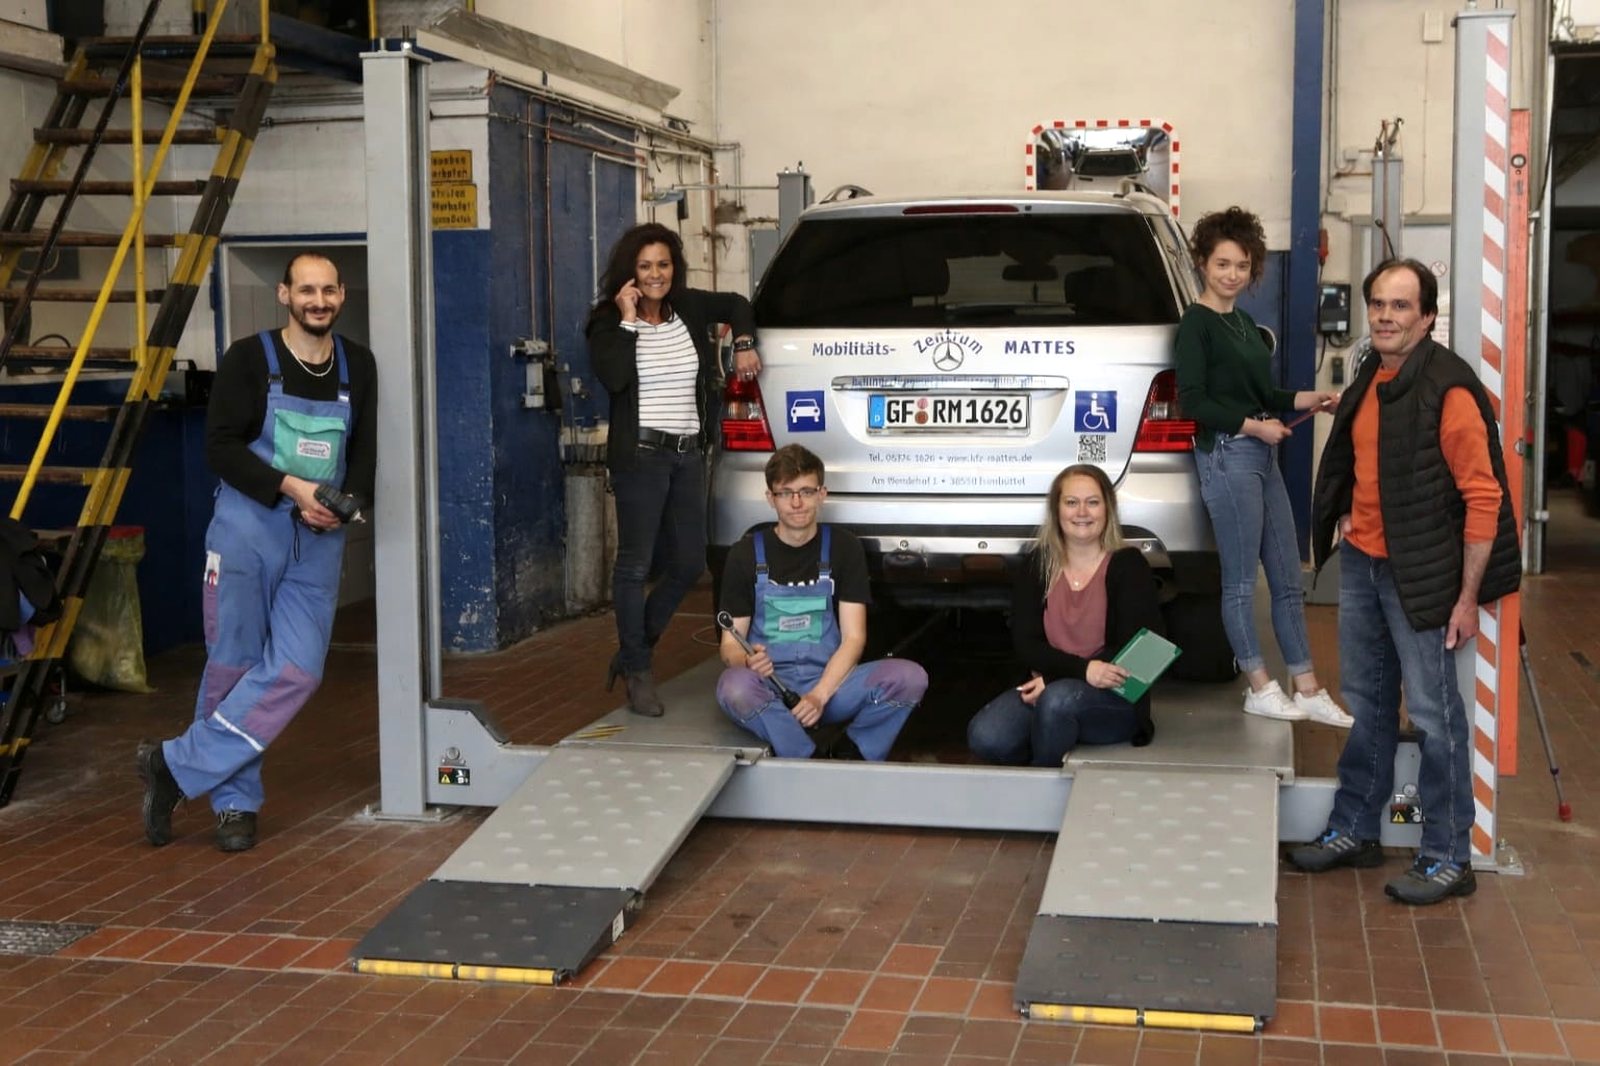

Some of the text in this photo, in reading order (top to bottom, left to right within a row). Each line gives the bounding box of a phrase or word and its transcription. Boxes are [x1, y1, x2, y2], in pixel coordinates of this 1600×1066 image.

[812, 331, 1076, 357] Mobilitäts- Zentrum MATTES
[886, 399, 915, 424] GF
